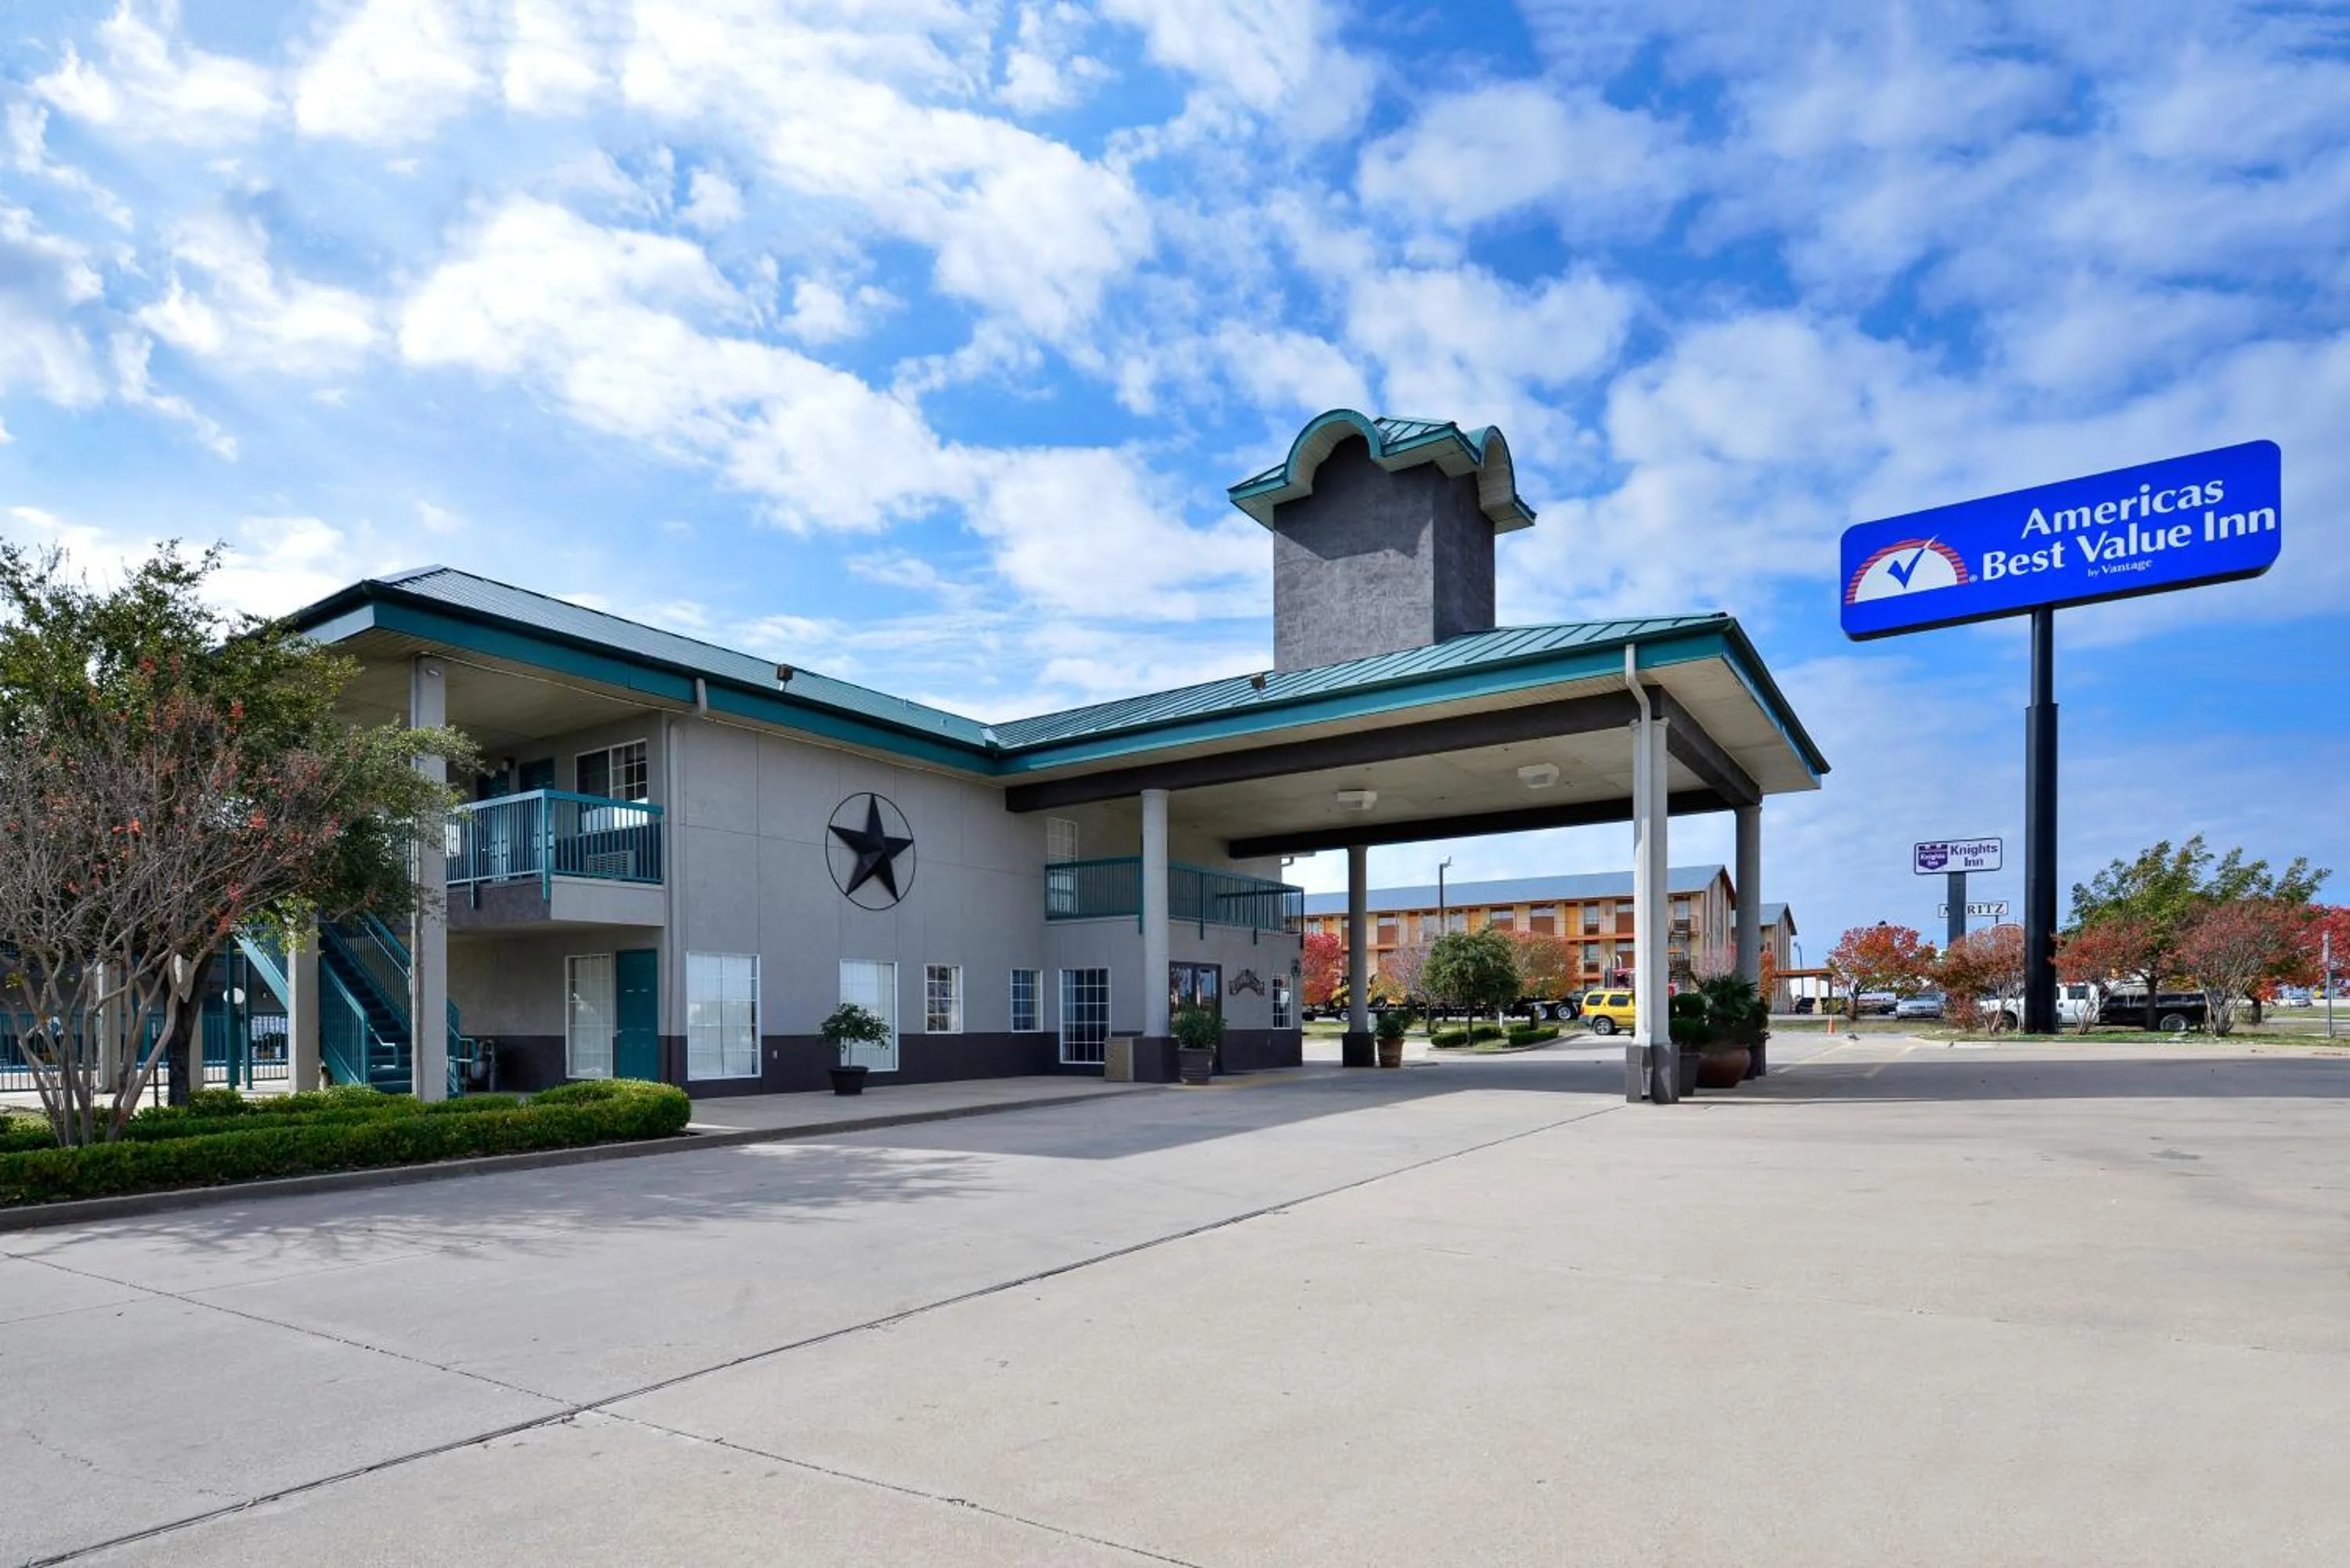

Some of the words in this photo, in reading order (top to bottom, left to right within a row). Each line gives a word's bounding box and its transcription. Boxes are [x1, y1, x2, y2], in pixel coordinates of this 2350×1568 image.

[2020, 479, 2224, 540] Americas
[1983, 540, 2066, 581] Best
[2076, 522, 2192, 563] Value
[2204, 507, 2276, 542] Inn
[2088, 568, 2099, 577] by
[2101, 560, 2153, 575] Vantage
[1950, 844, 1998, 857] Knights
[1964, 857, 1984, 867] Inn
[1943, 903, 2005, 915] RITZ
